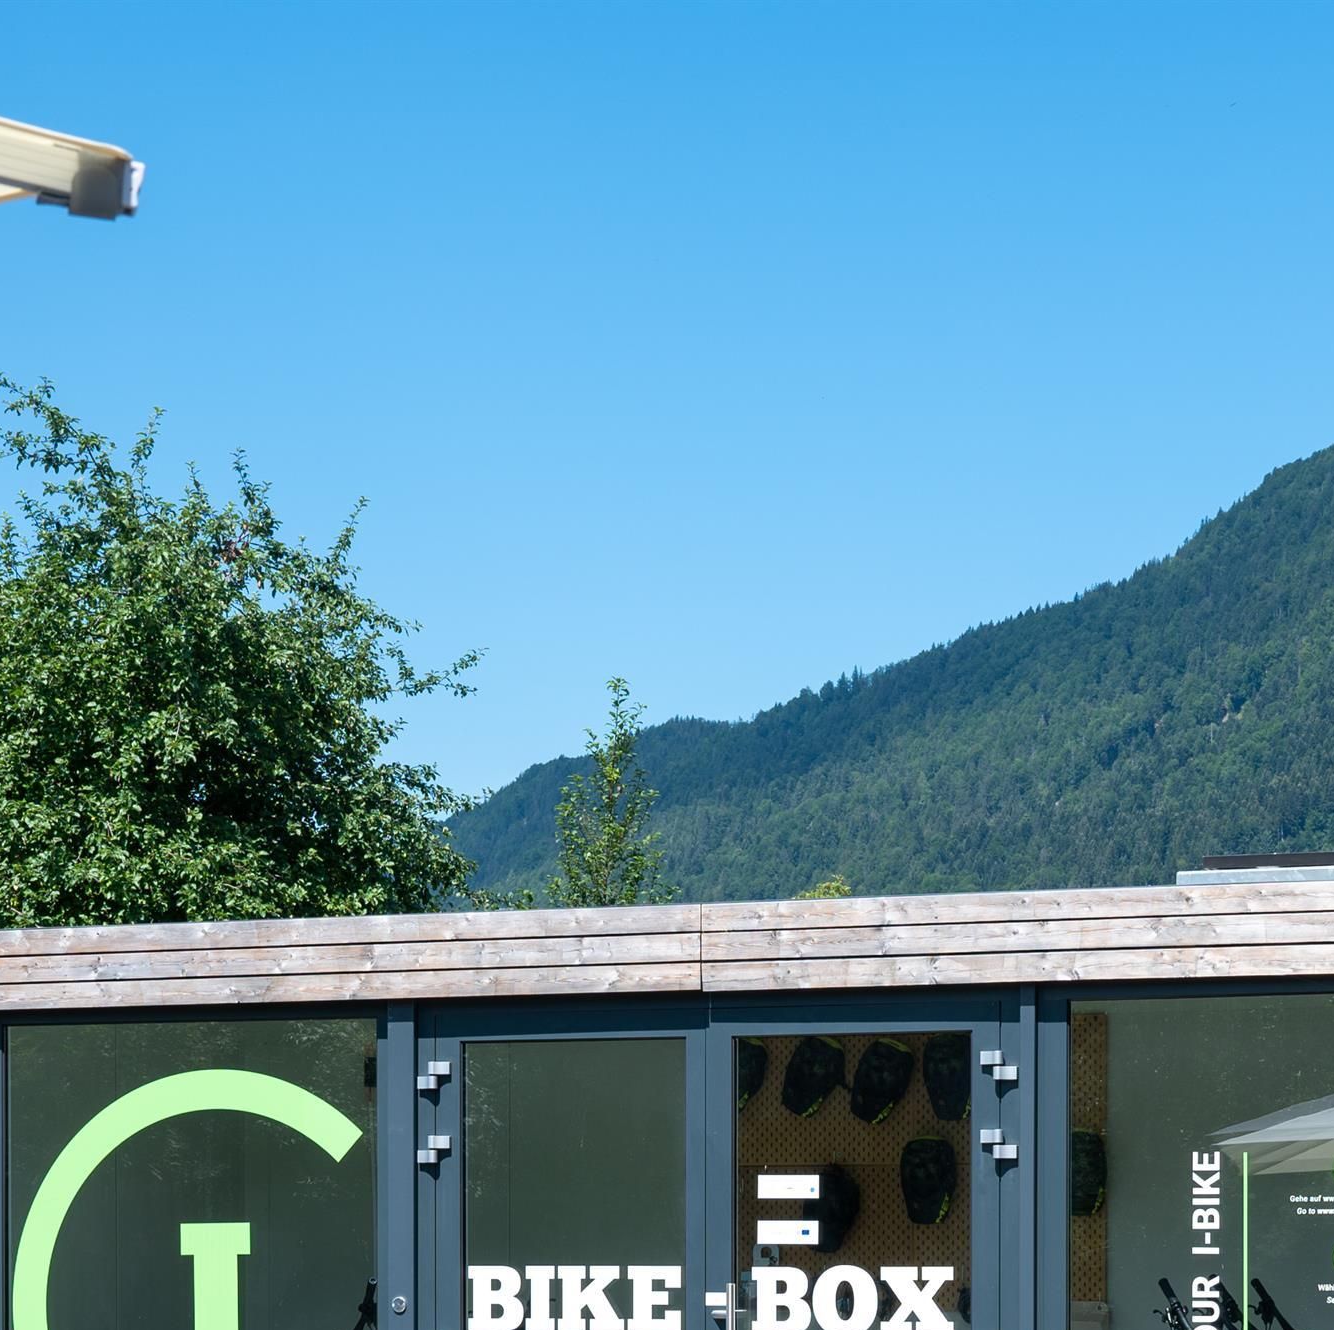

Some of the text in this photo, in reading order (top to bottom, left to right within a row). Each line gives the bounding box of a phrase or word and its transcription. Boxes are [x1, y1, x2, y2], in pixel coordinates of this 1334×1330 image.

[1191, 1151, 1221, 1255] I-BIKE
[1289, 1195, 1309, 1203] Gehe
[1310, 1195, 1322, 1203] auf
[1296, 1207, 1307, 1215] Go
[1308, 1207, 1316, 1215] to
